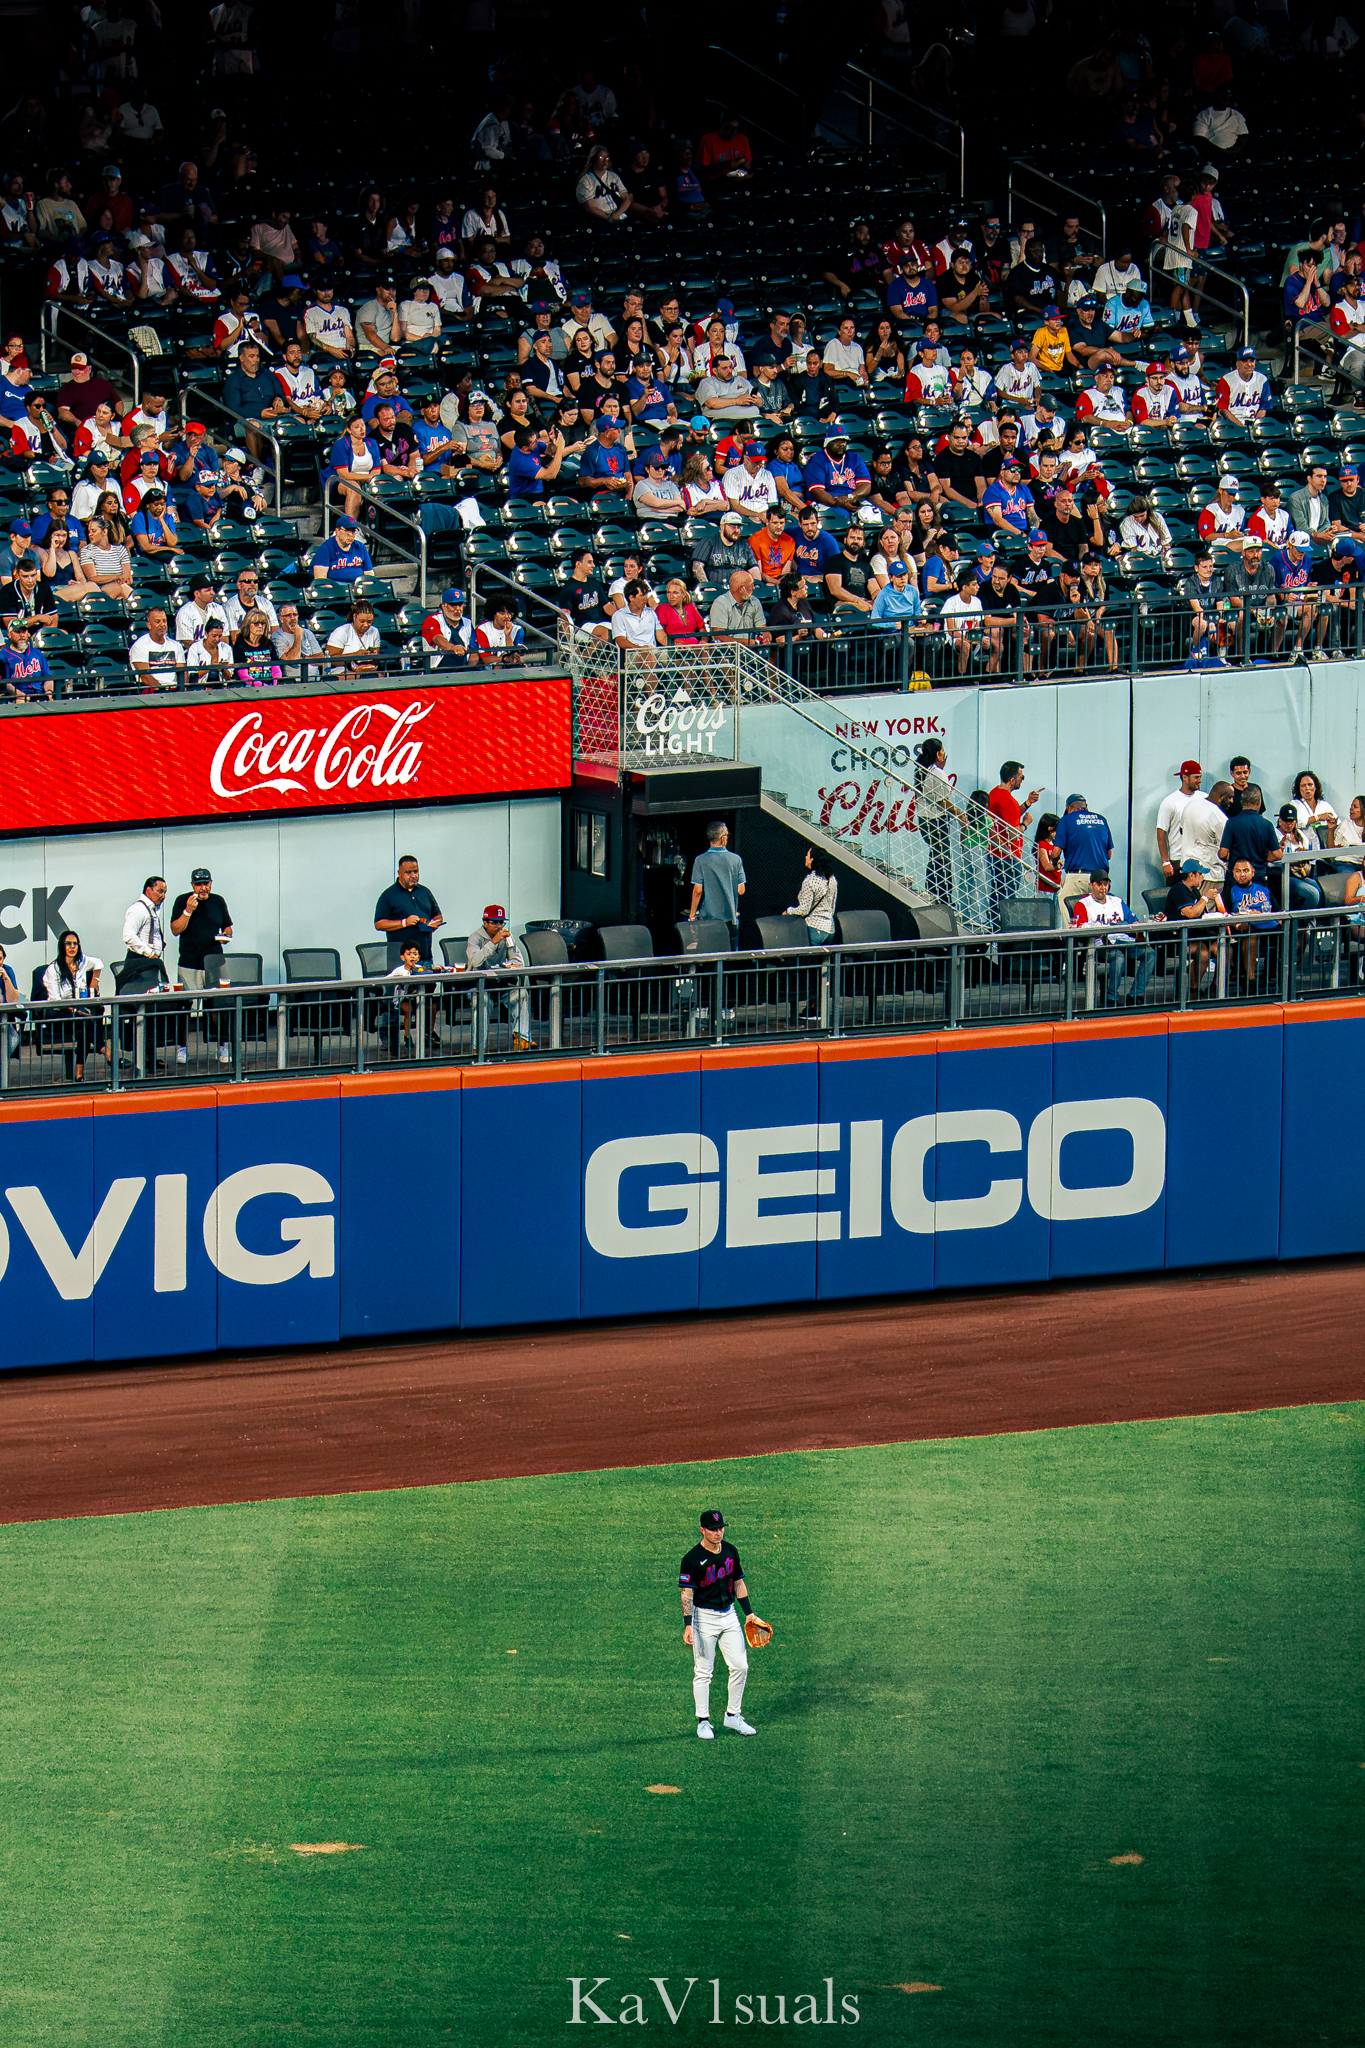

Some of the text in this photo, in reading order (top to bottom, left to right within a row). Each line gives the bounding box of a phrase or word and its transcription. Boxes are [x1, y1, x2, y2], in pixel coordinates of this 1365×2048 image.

[1230, 391, 1261, 408] Mets
[739, 483, 769, 501] Mets
[1280, 569, 1308, 589] Mets
[10, 657, 42, 680] Mets
[636, 693, 727, 734] Coors
[835, 715, 946, 739] NEW YORK,
[210, 701, 436, 797] Coca-Cola
[646, 732, 717, 756] LIGHT
[585, 1097, 1166, 1258] GEICO
[0, 1163, 335, 1300] VIG
